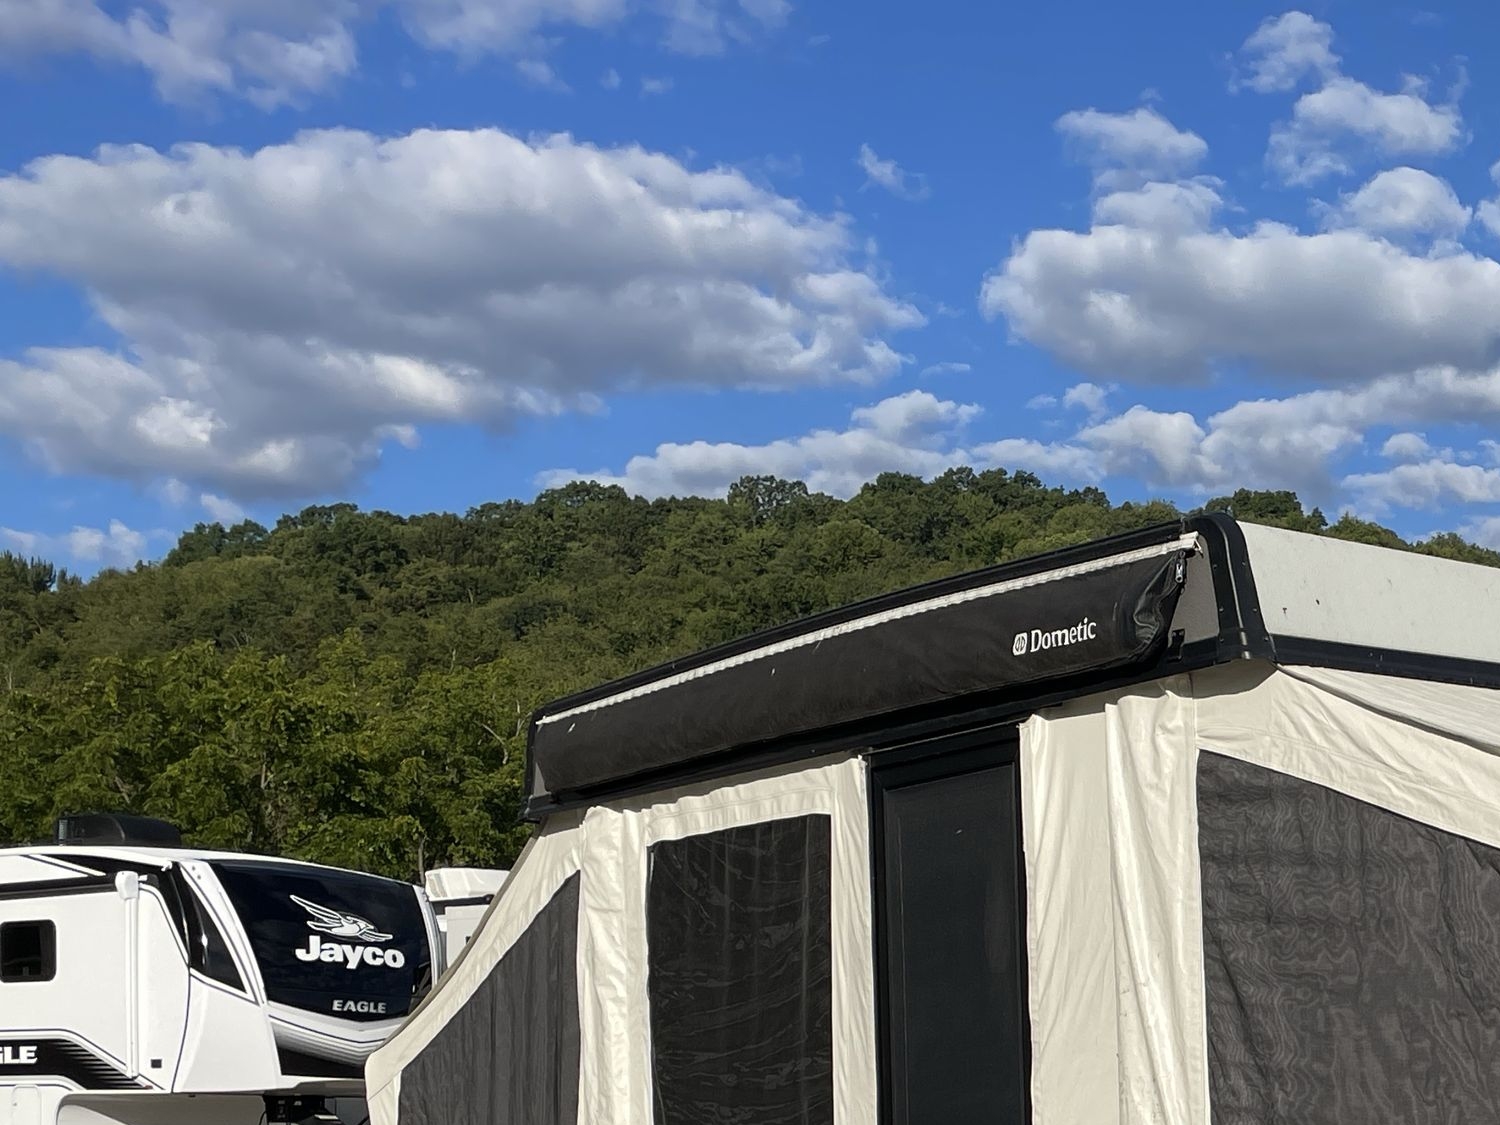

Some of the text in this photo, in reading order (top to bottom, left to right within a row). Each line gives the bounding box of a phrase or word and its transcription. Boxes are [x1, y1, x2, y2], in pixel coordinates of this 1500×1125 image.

[1030, 617, 1097, 653] Dometic
[295, 935, 405, 969] Jayco
[332, 999, 387, 1014] EAGLE
